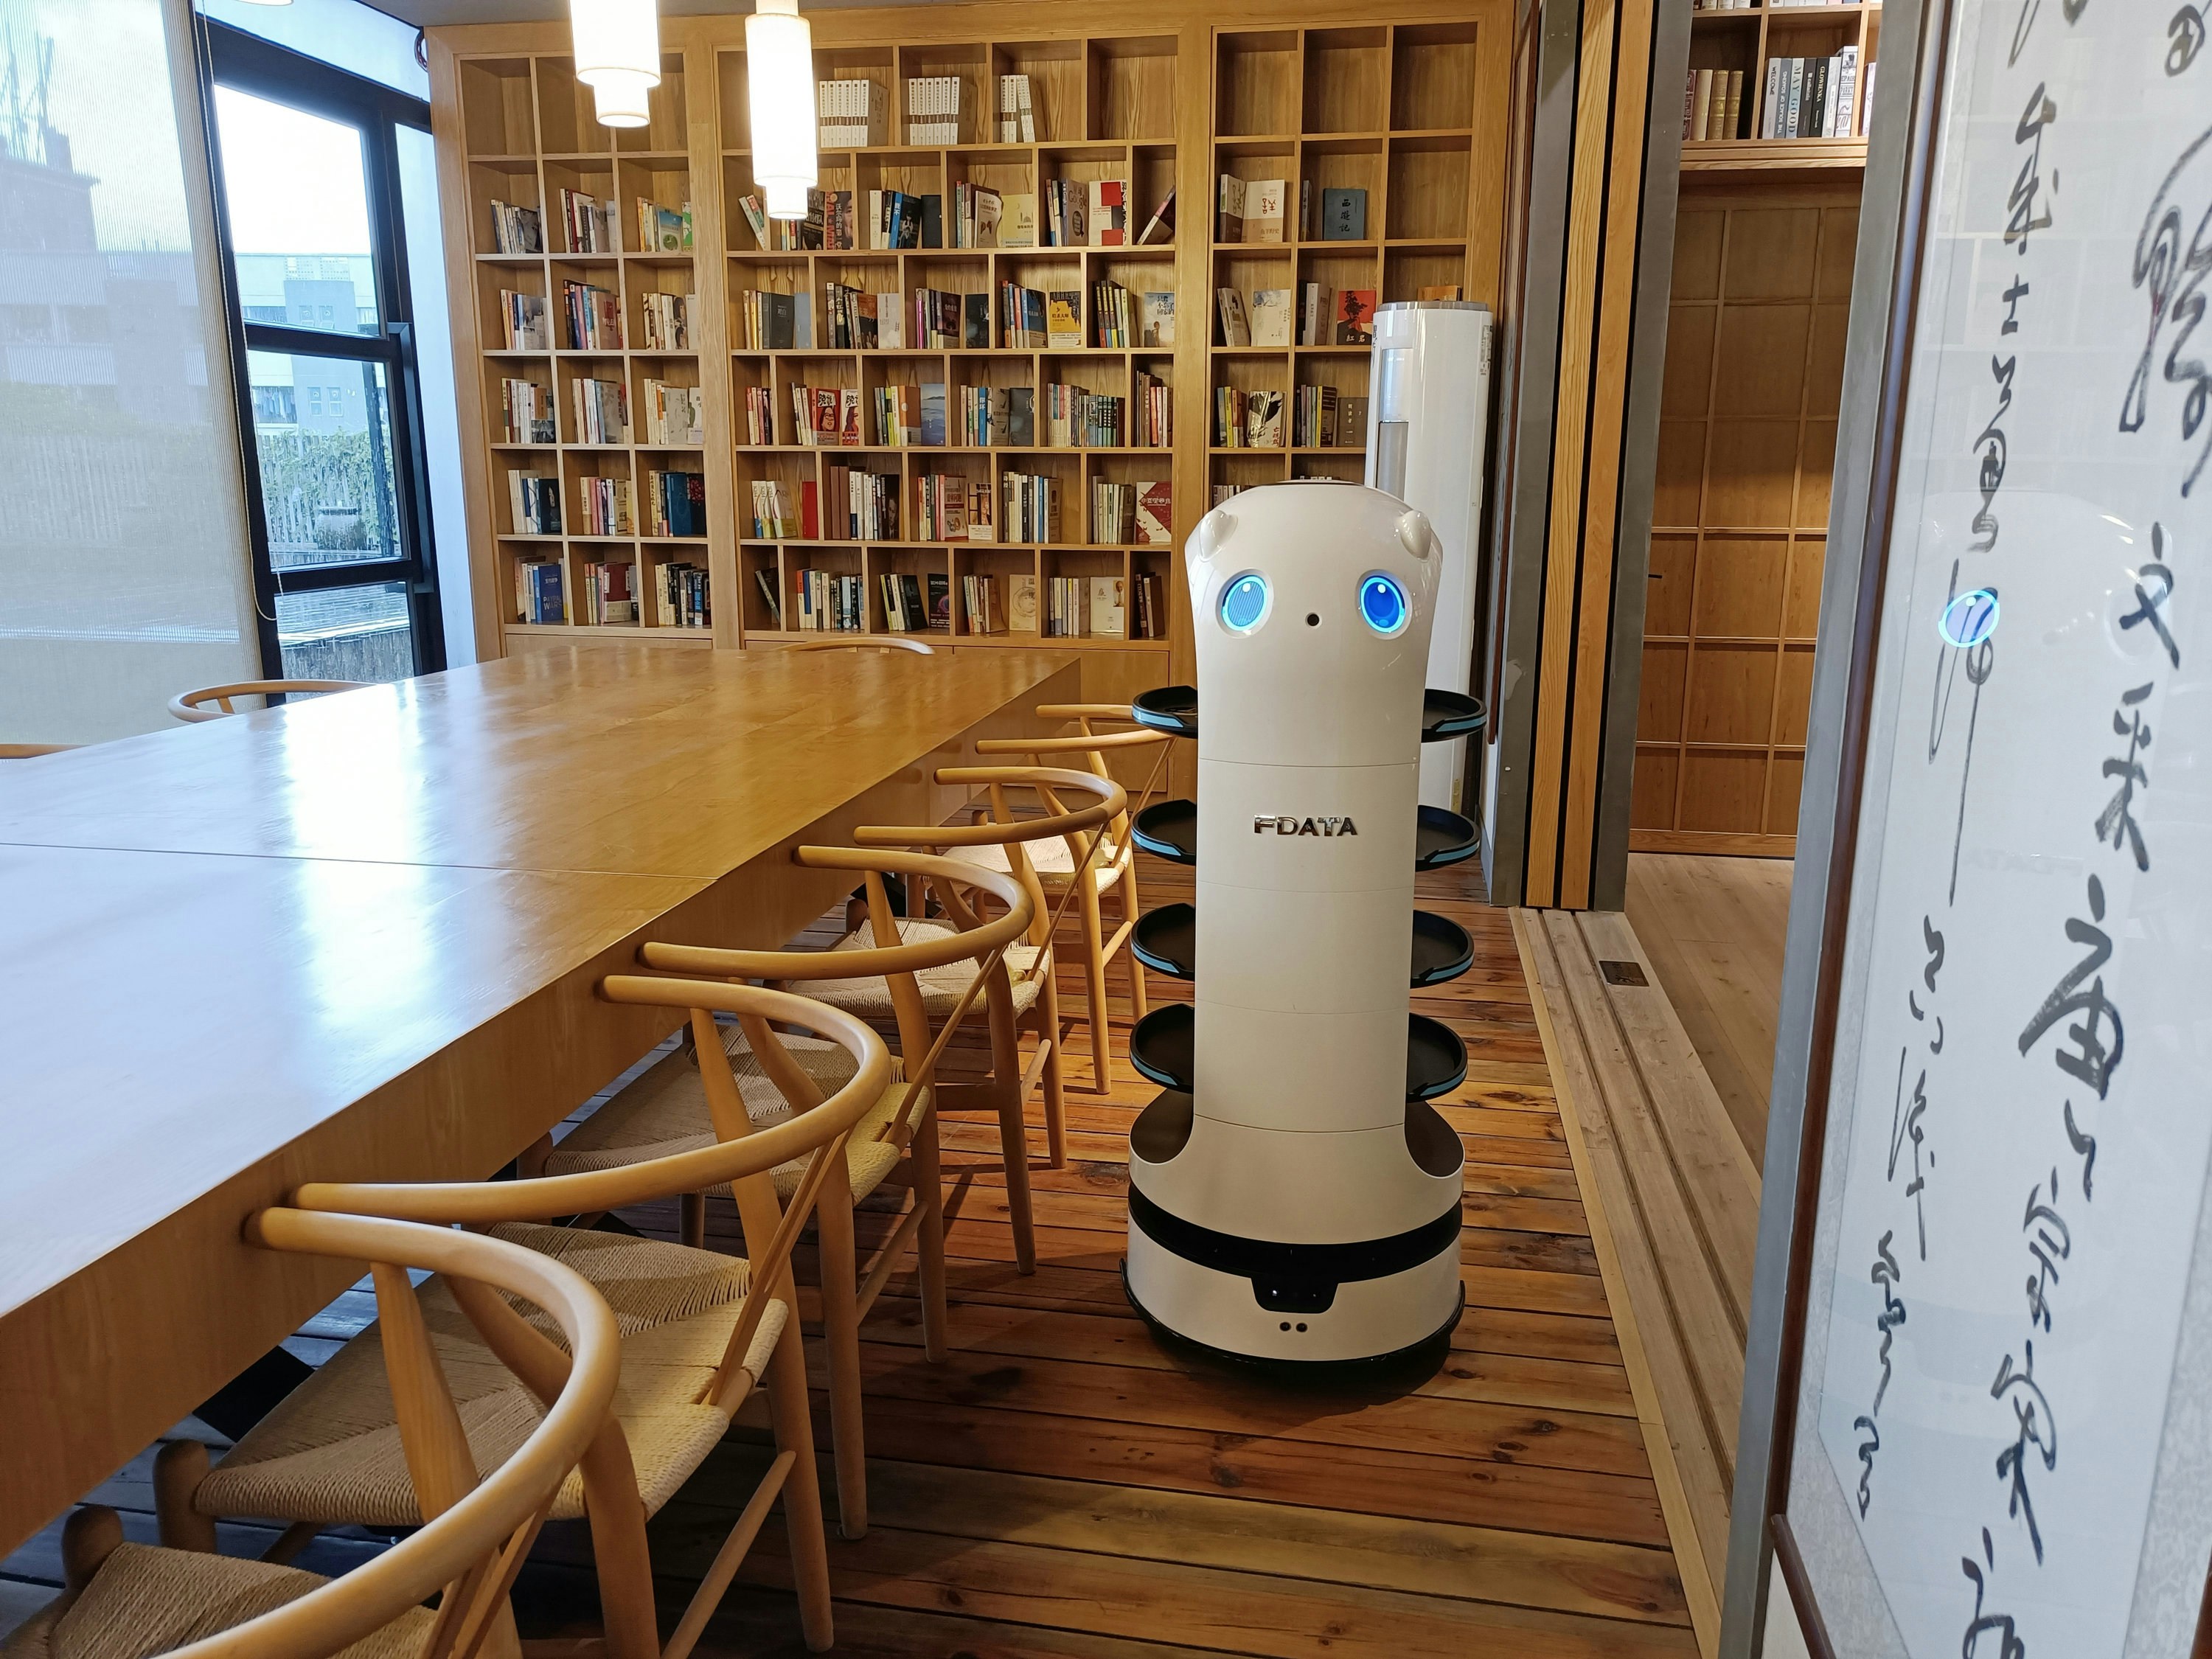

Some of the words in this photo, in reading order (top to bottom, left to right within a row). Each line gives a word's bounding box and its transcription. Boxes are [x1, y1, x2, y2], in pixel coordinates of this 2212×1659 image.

[1769, 66, 1777, 96] WELCOME
[1793, 66, 1802, 94] MAY
[1788, 98, 1798, 133] GOOD
[1253, 814, 1358, 837] FDATA
